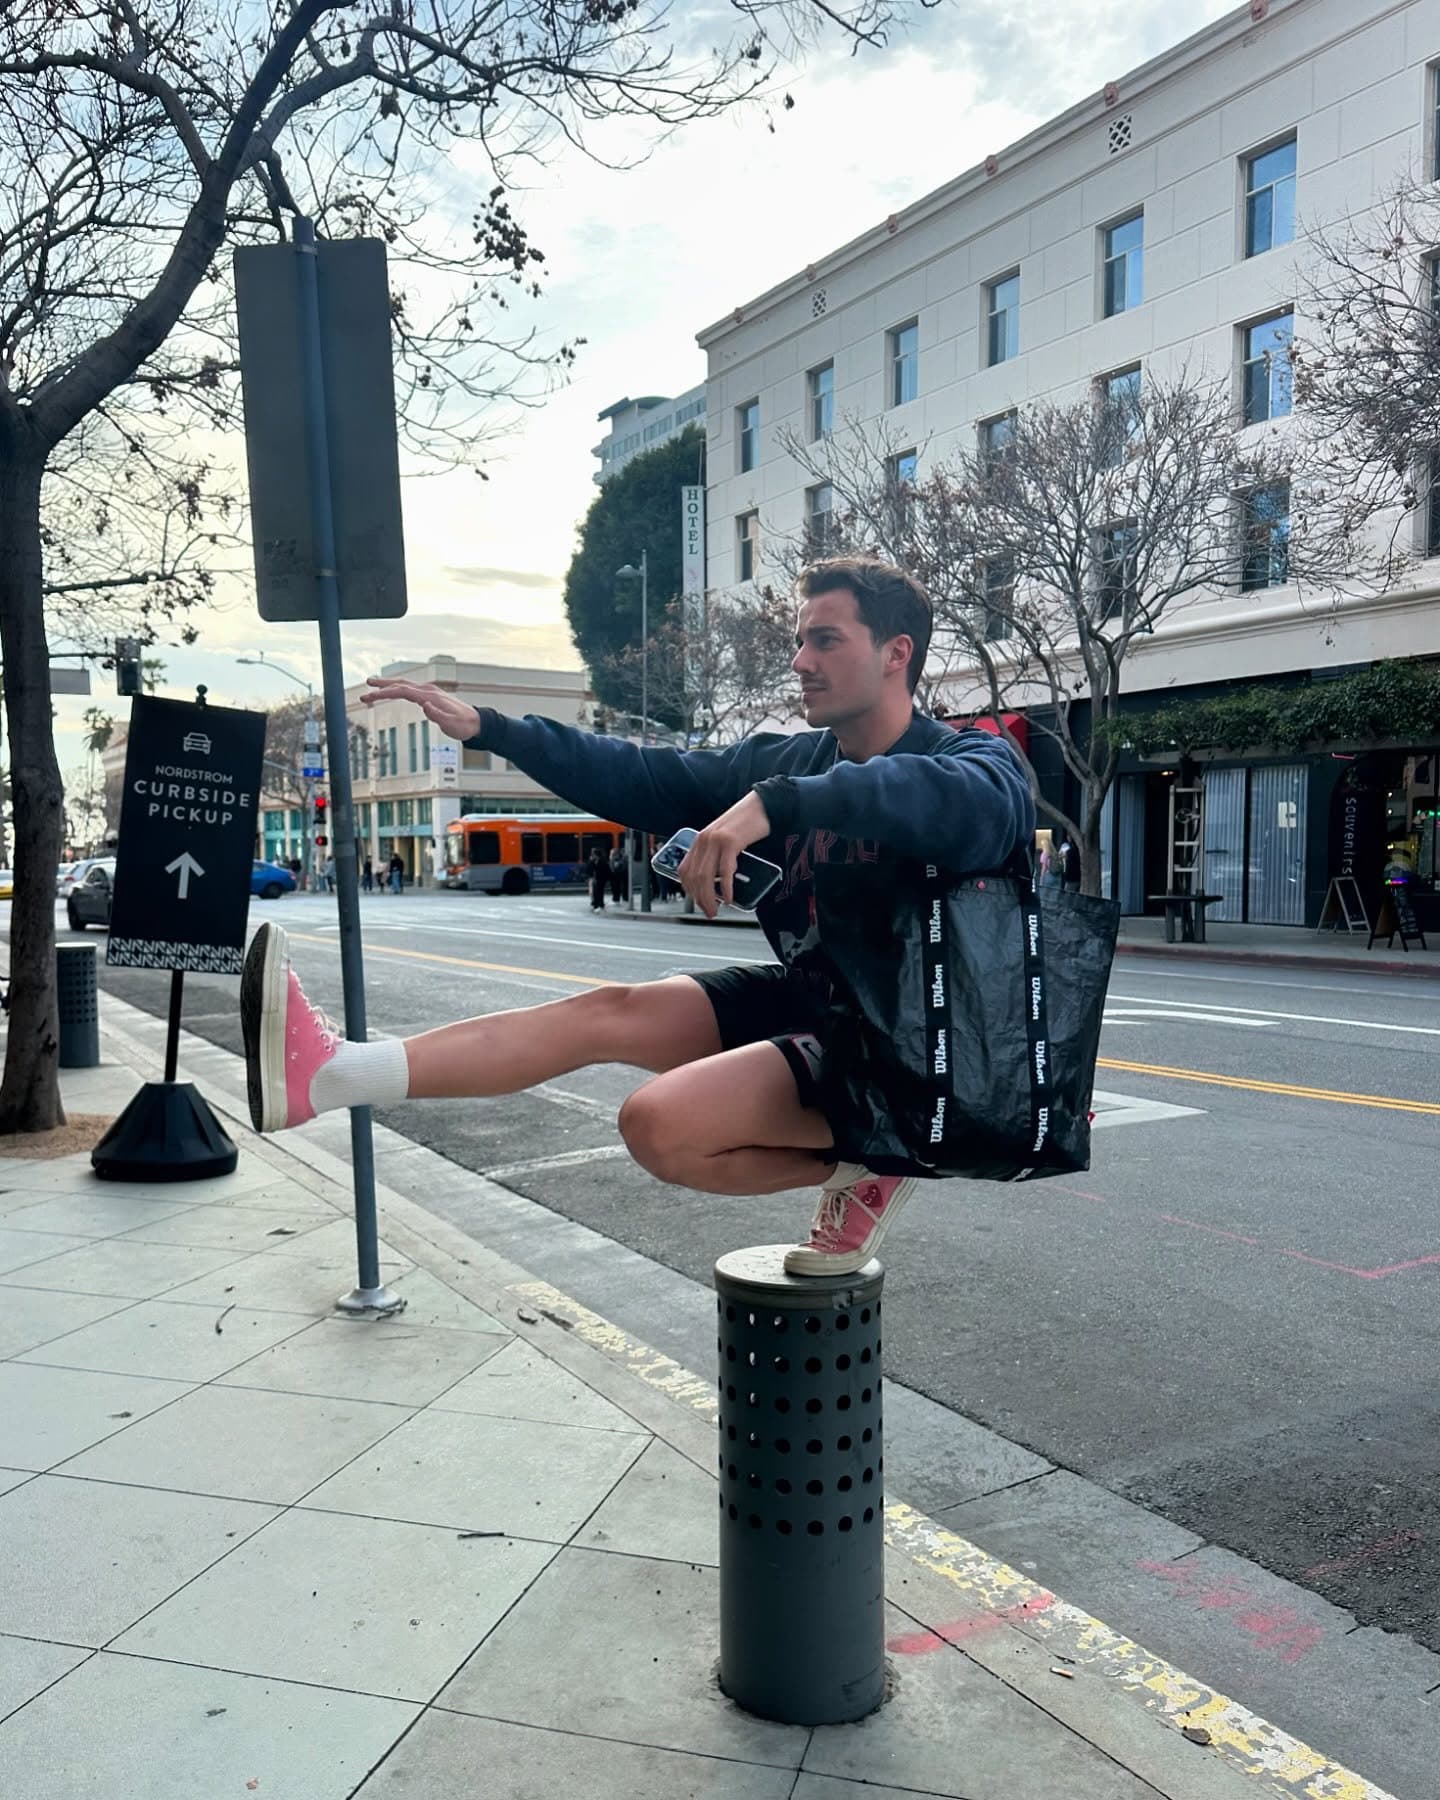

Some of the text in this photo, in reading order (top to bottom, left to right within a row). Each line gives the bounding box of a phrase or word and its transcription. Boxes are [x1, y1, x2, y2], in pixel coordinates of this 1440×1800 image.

[687, 488, 698, 555] HOTEL
[133, 779, 250, 808] CURBSIDE
[155, 764, 233, 784] NORDSTROM
[148, 802, 233, 825] PICKUP
[929, 899, 942, 944] Wilson
[1028, 914, 1039, 956] Wilson
[931, 963, 945, 1009] Wilson
[1031, 976, 1042, 1021] Wilson
[934, 1028, 947, 1075] Wilson
[1035, 1039, 1047, 1085] Wilson
[929, 1096, 946, 1144] Wilson
[1032, 1106, 1049, 1152] Wilson
